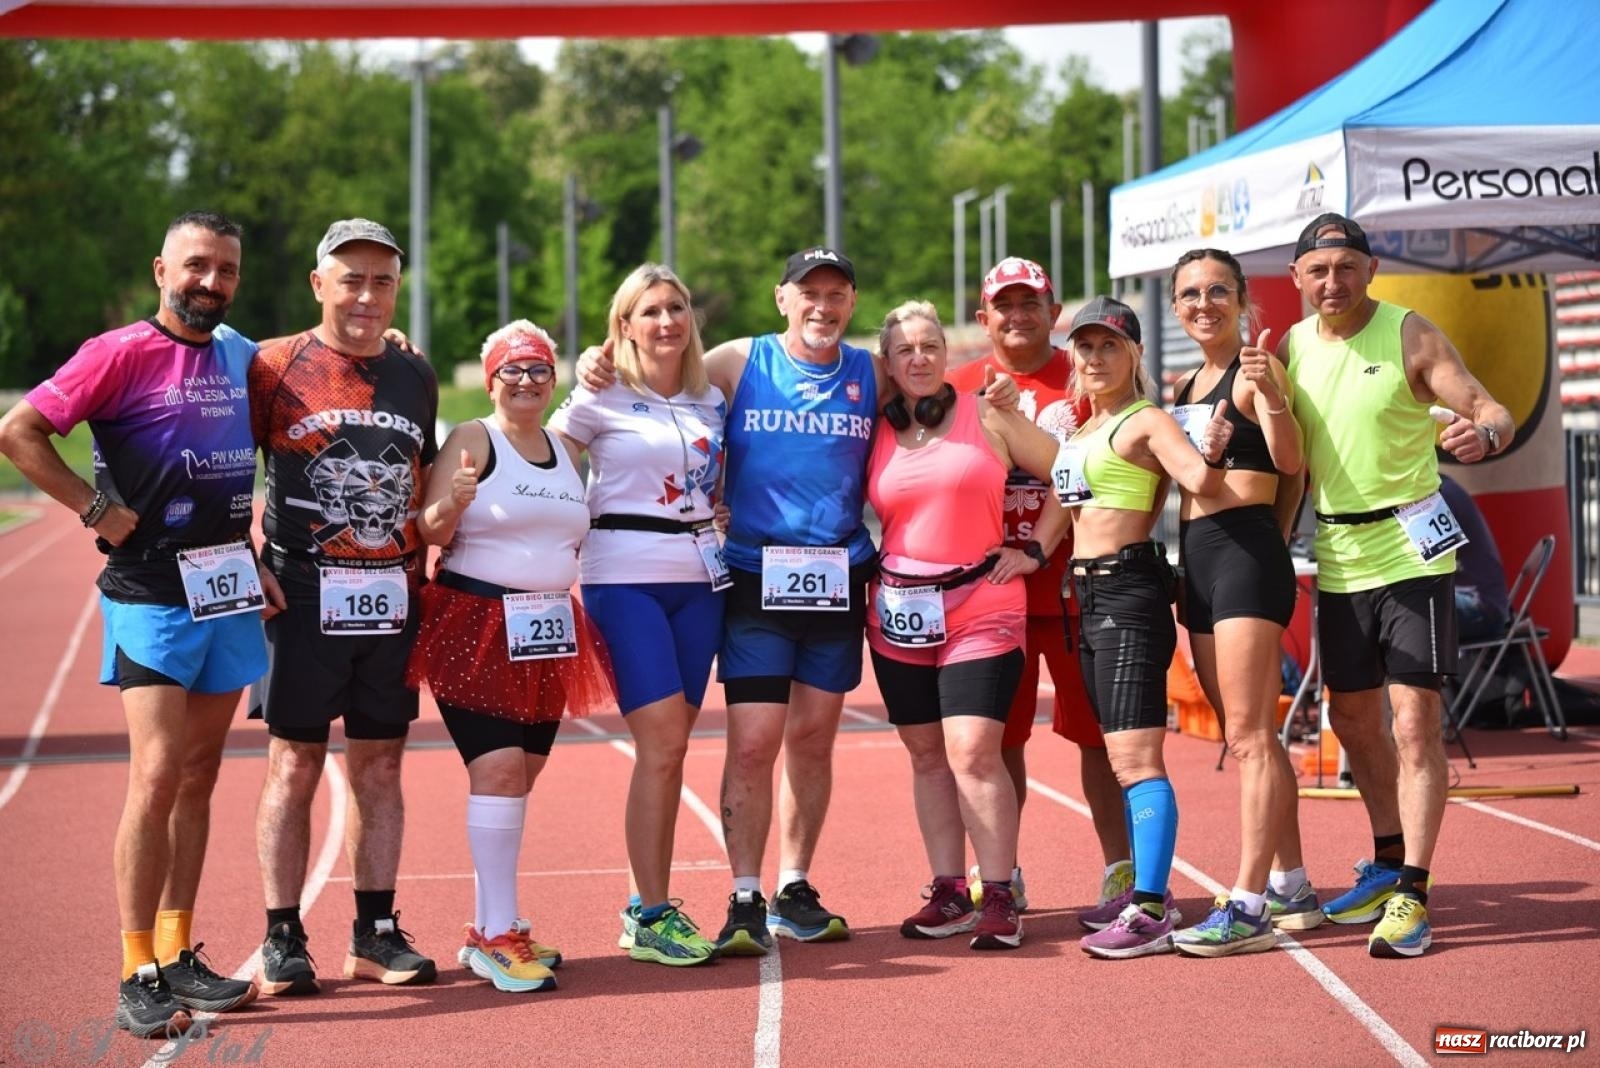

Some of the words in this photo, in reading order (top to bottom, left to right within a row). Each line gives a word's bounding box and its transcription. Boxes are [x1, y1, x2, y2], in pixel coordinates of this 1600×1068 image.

[1402, 150, 1600, 201] Personal
[804, 249, 839, 262] FILA
[186, 389, 229, 403] SILESIA
[201, 406, 235, 418] RYBNIK
[743, 408, 872, 440] RUNNERS
[206, 572, 239, 599] 167
[787, 572, 826, 594] 261
[345, 593, 389, 616] 186
[530, 618, 565, 641] 233
[885, 609, 924, 632] 260
